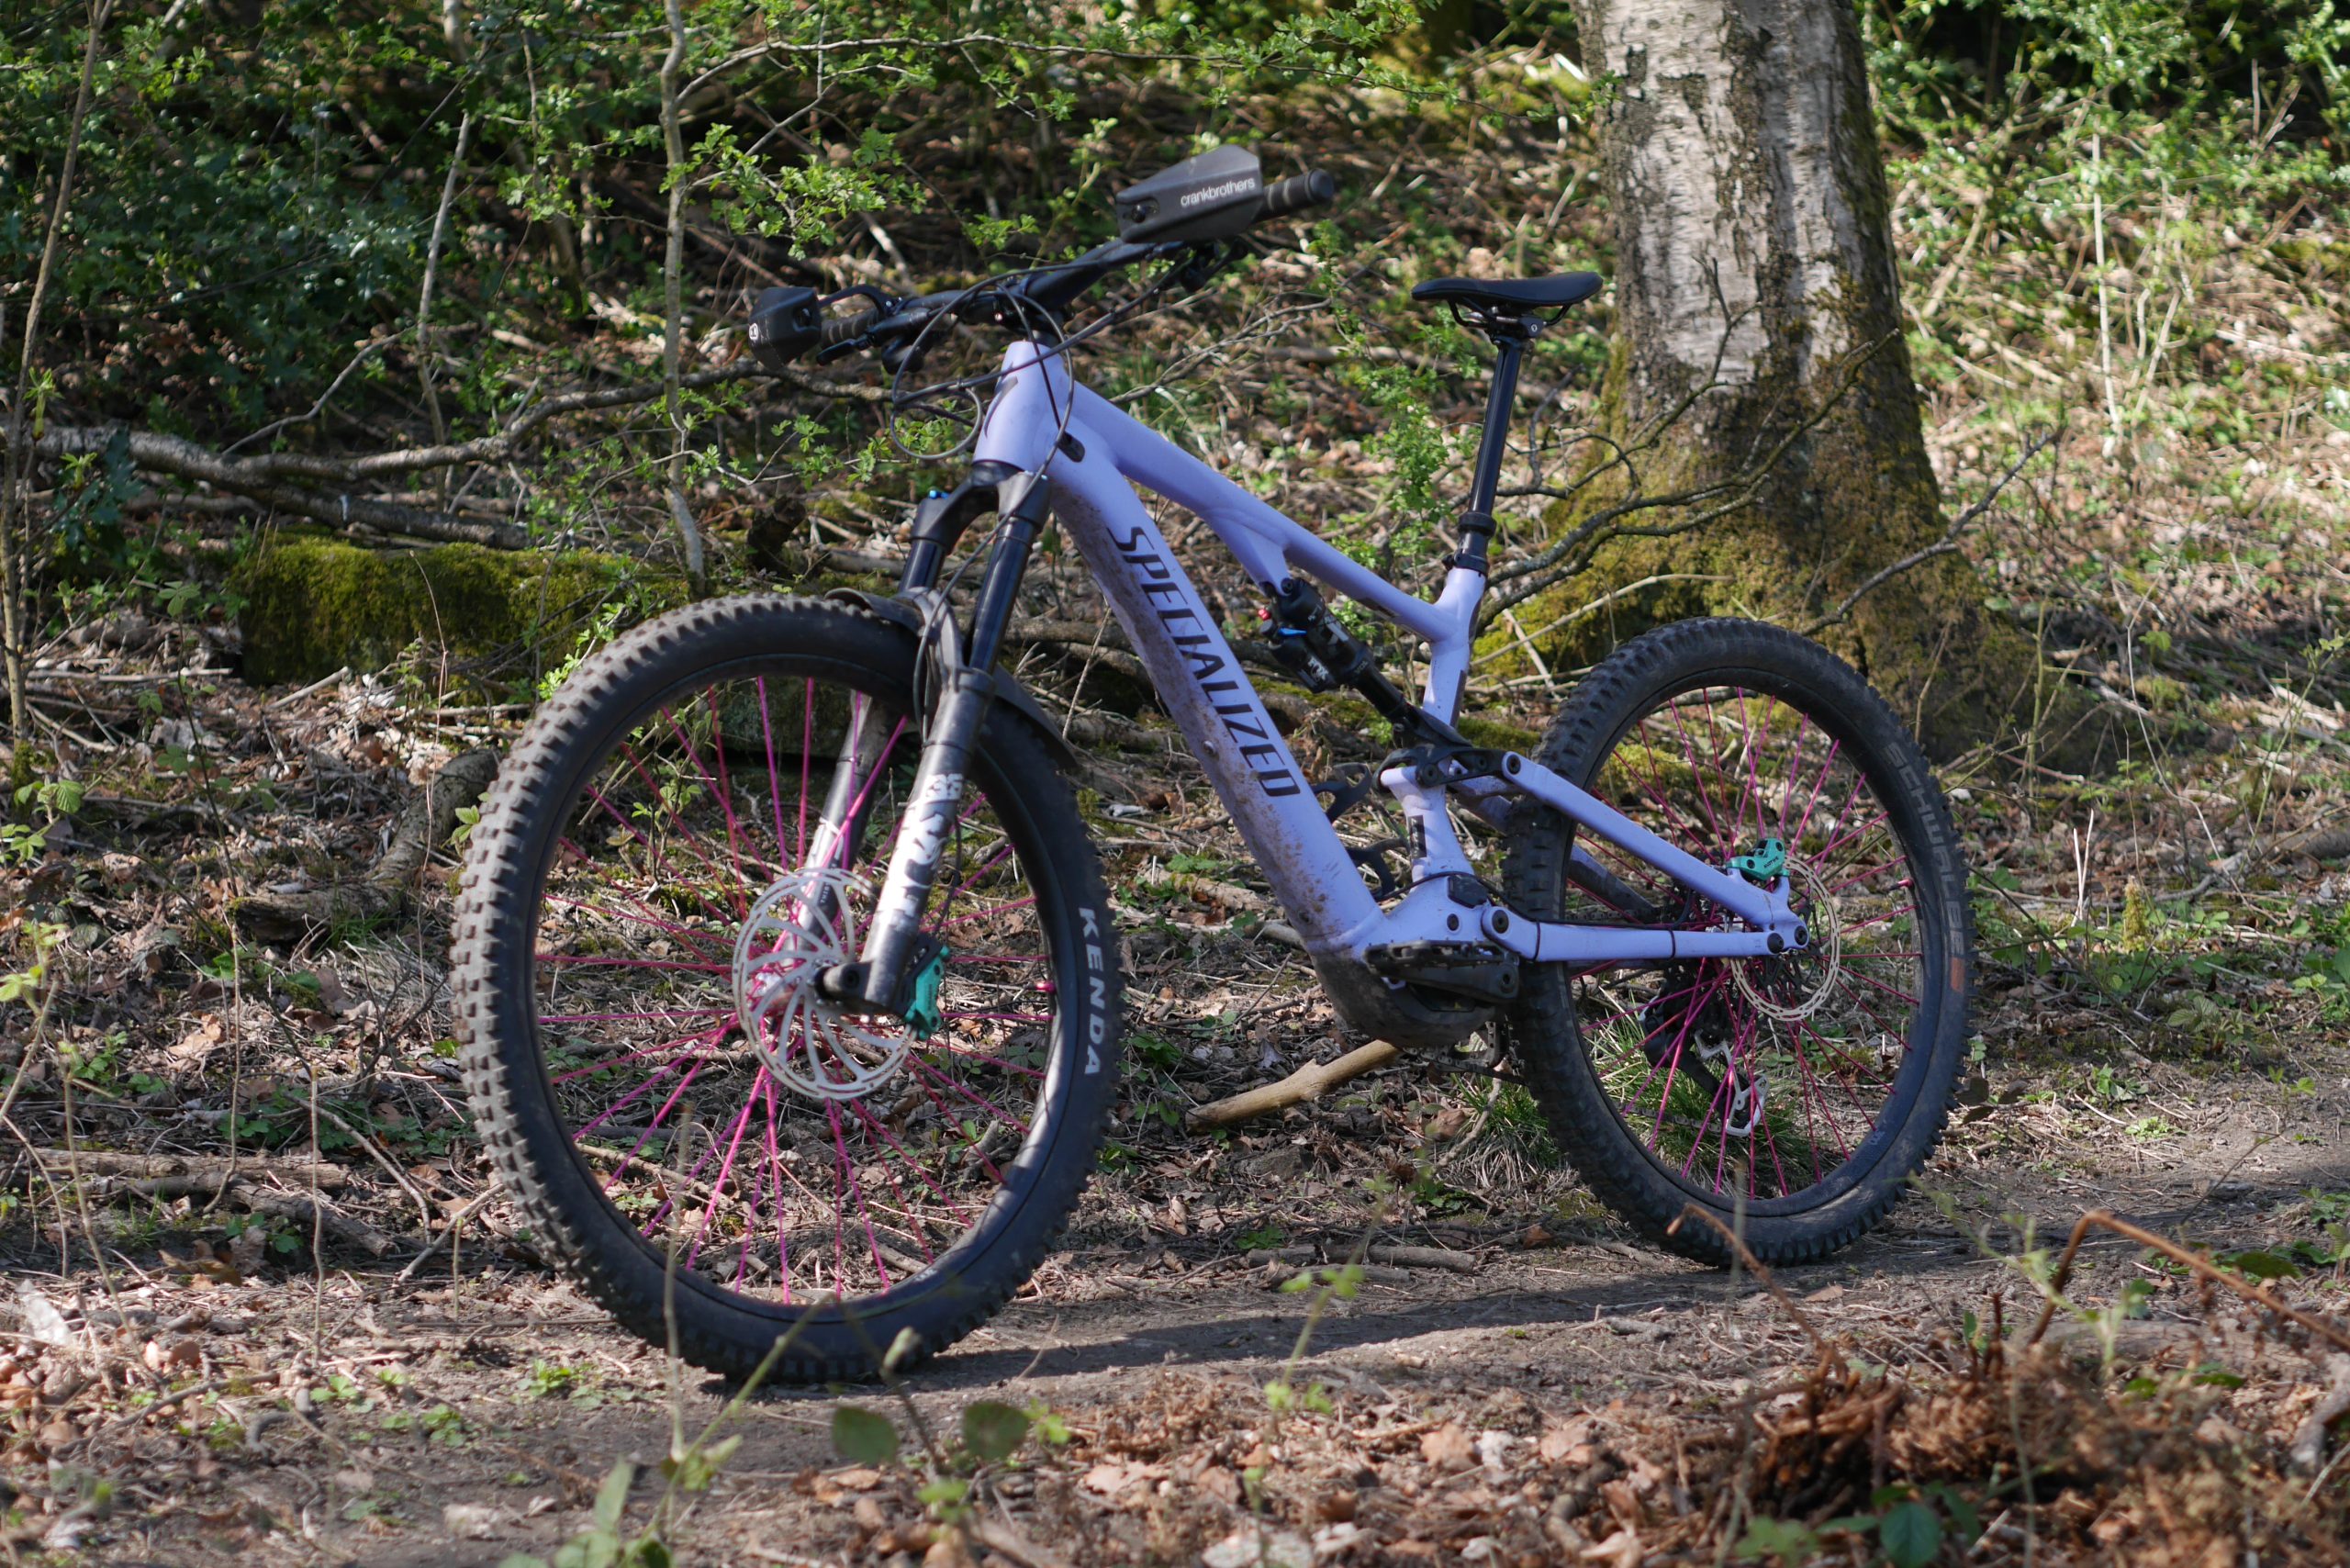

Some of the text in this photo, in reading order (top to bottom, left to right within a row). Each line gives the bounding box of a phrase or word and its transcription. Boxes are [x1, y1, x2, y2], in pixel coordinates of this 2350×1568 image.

[1181, 177, 1256, 207] crankbrothers
[1107, 526, 1301, 797] SPECIALIZED
[1886, 742, 1964, 956] SCHWALBE
[1079, 907, 1106, 1075] KENDA
